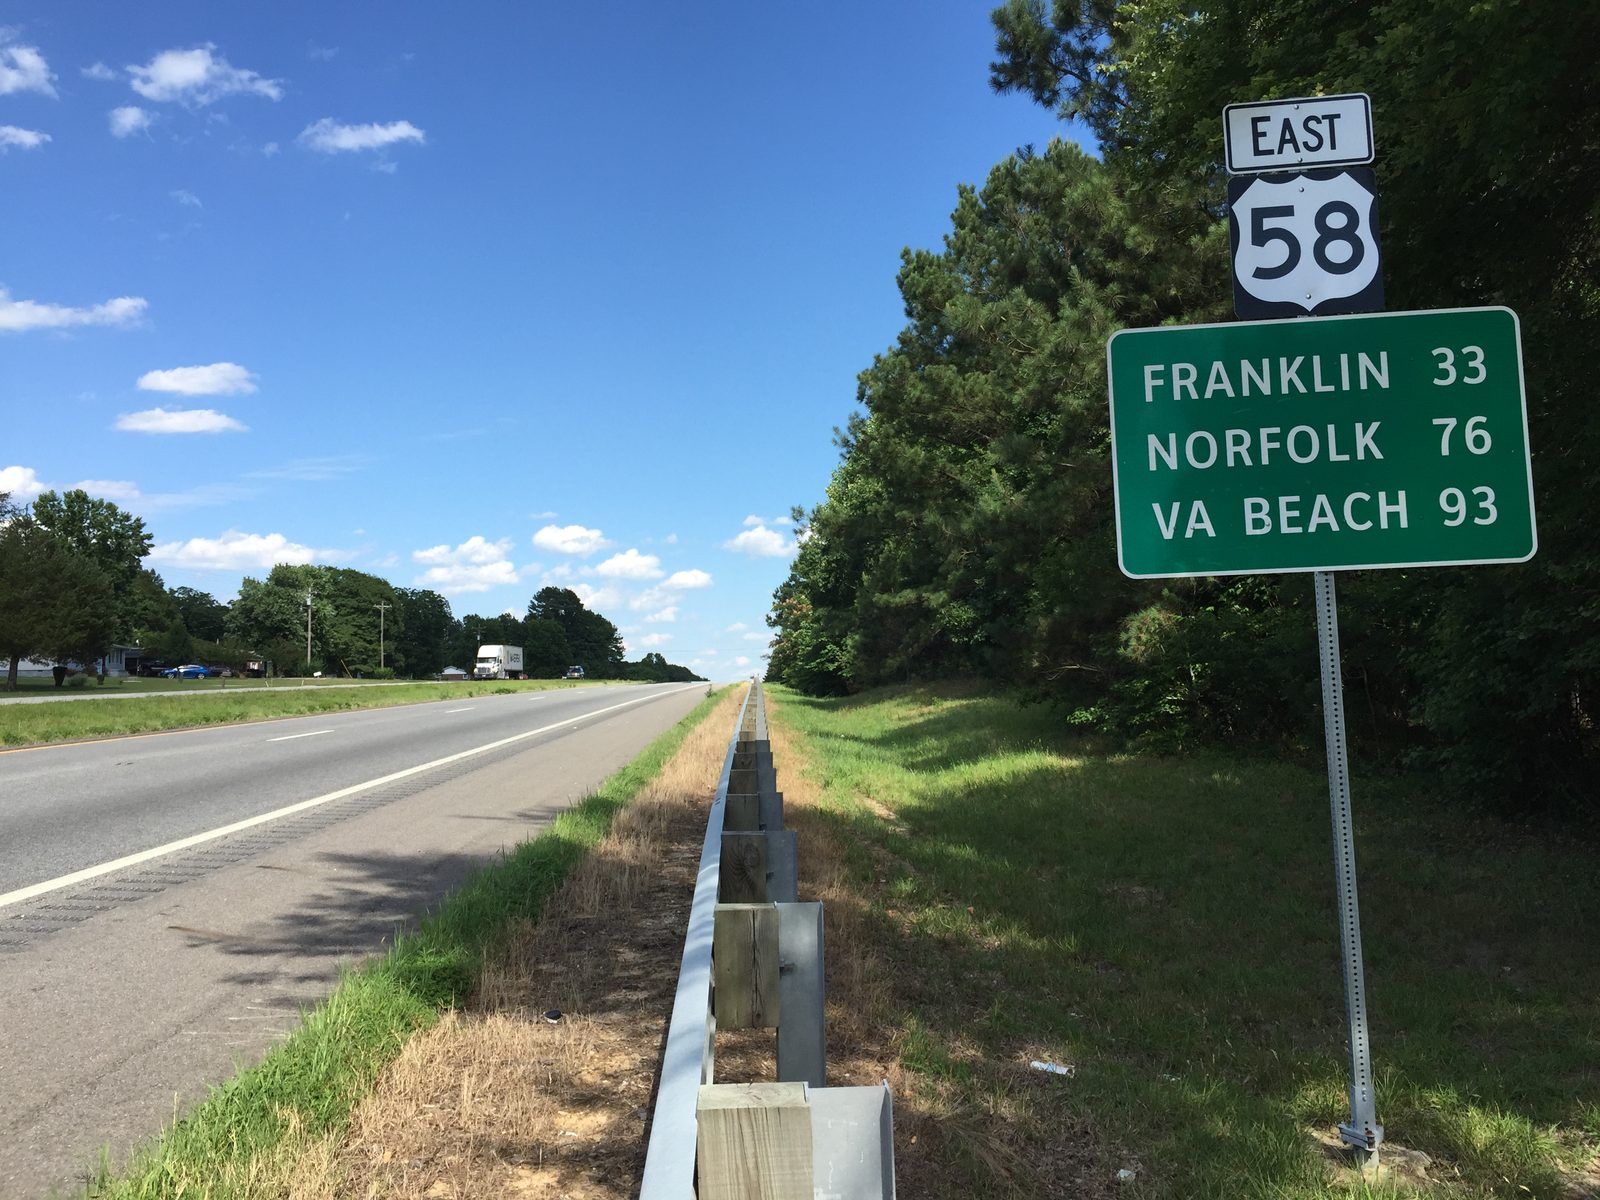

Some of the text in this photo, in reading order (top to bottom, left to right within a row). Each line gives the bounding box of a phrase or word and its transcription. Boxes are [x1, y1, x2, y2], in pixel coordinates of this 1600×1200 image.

[1250, 113, 1341, 157] EAST
[1250, 200, 1365, 281] 58
[1143, 345, 1487, 403] FRANKLIN 33
[1147, 415, 1492, 471] NORFOLK 76
[1151, 485, 1498, 540] VA BEACH 93
